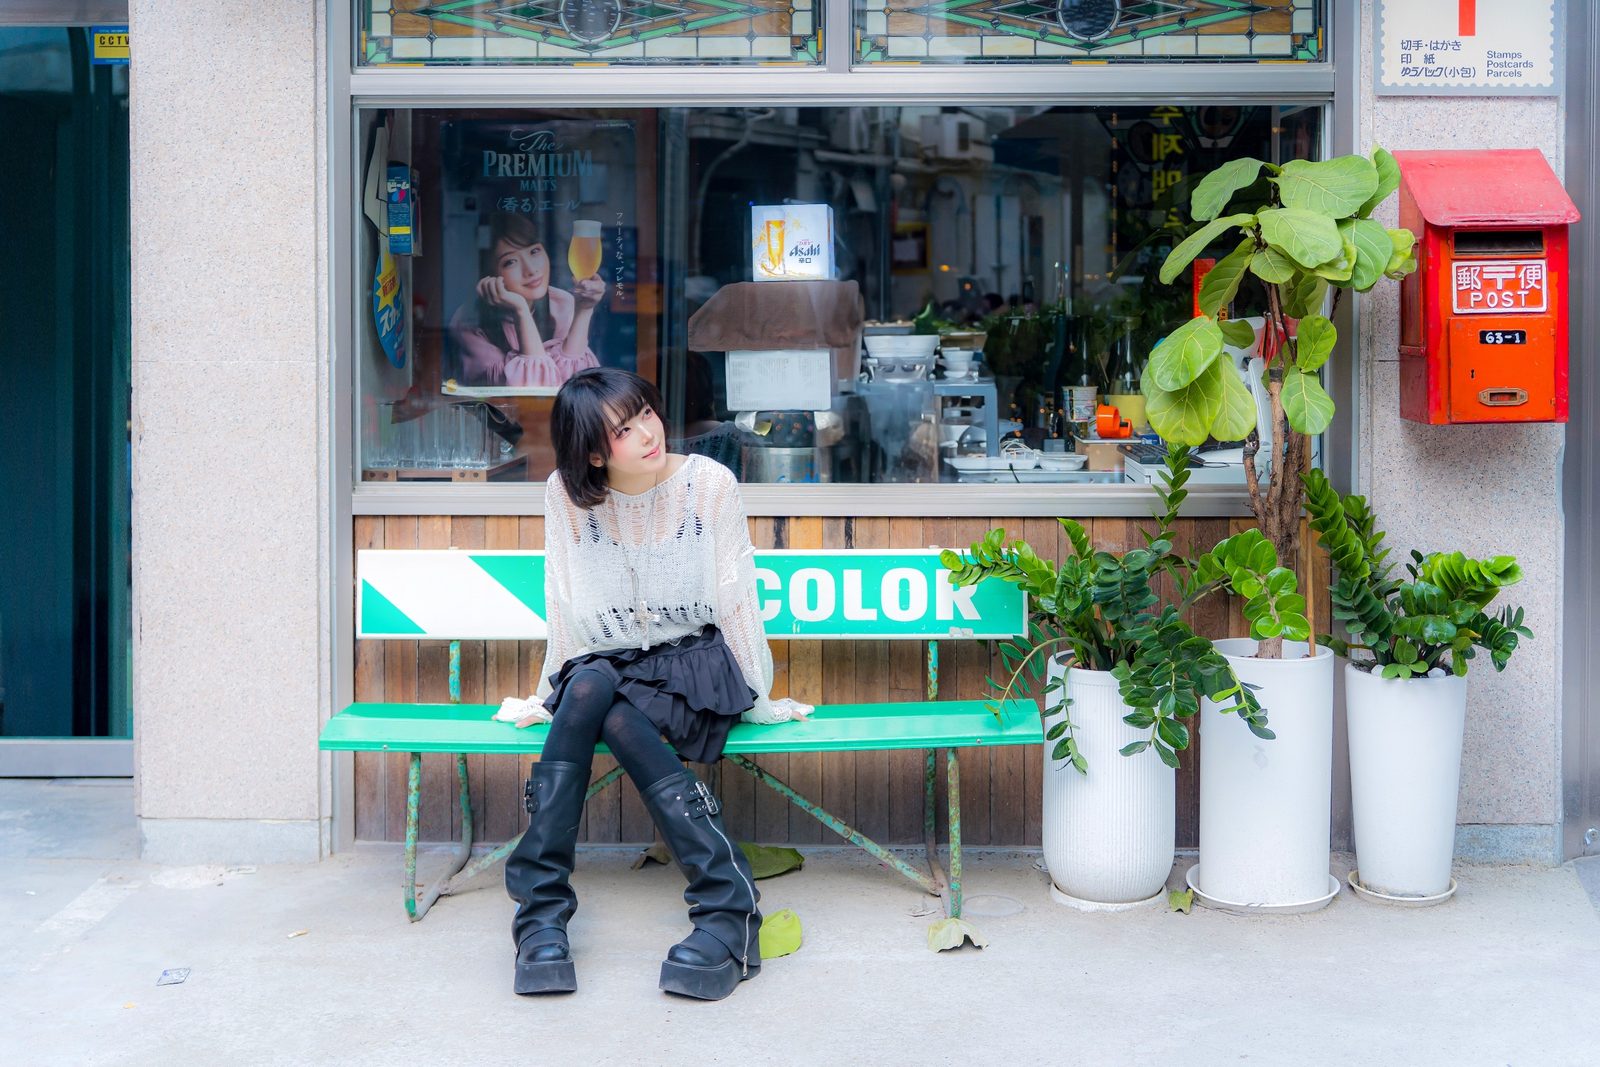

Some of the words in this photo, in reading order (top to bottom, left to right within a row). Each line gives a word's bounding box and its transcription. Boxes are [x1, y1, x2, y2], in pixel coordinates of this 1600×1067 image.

[1401, 39, 1462, 51] 切手・はがき
[1487, 51, 1522, 60] Stamps
[1486, 60, 1534, 69] Postcards
[1486, 69, 1522, 78] Parcels
[482, 150, 593, 177] PREMIUM
[789, 244, 820, 257] Asahi
[1470, 291, 1530, 308] POST
[1485, 332, 1521, 344] 63-1
[753, 567, 982, 622] COLOR
